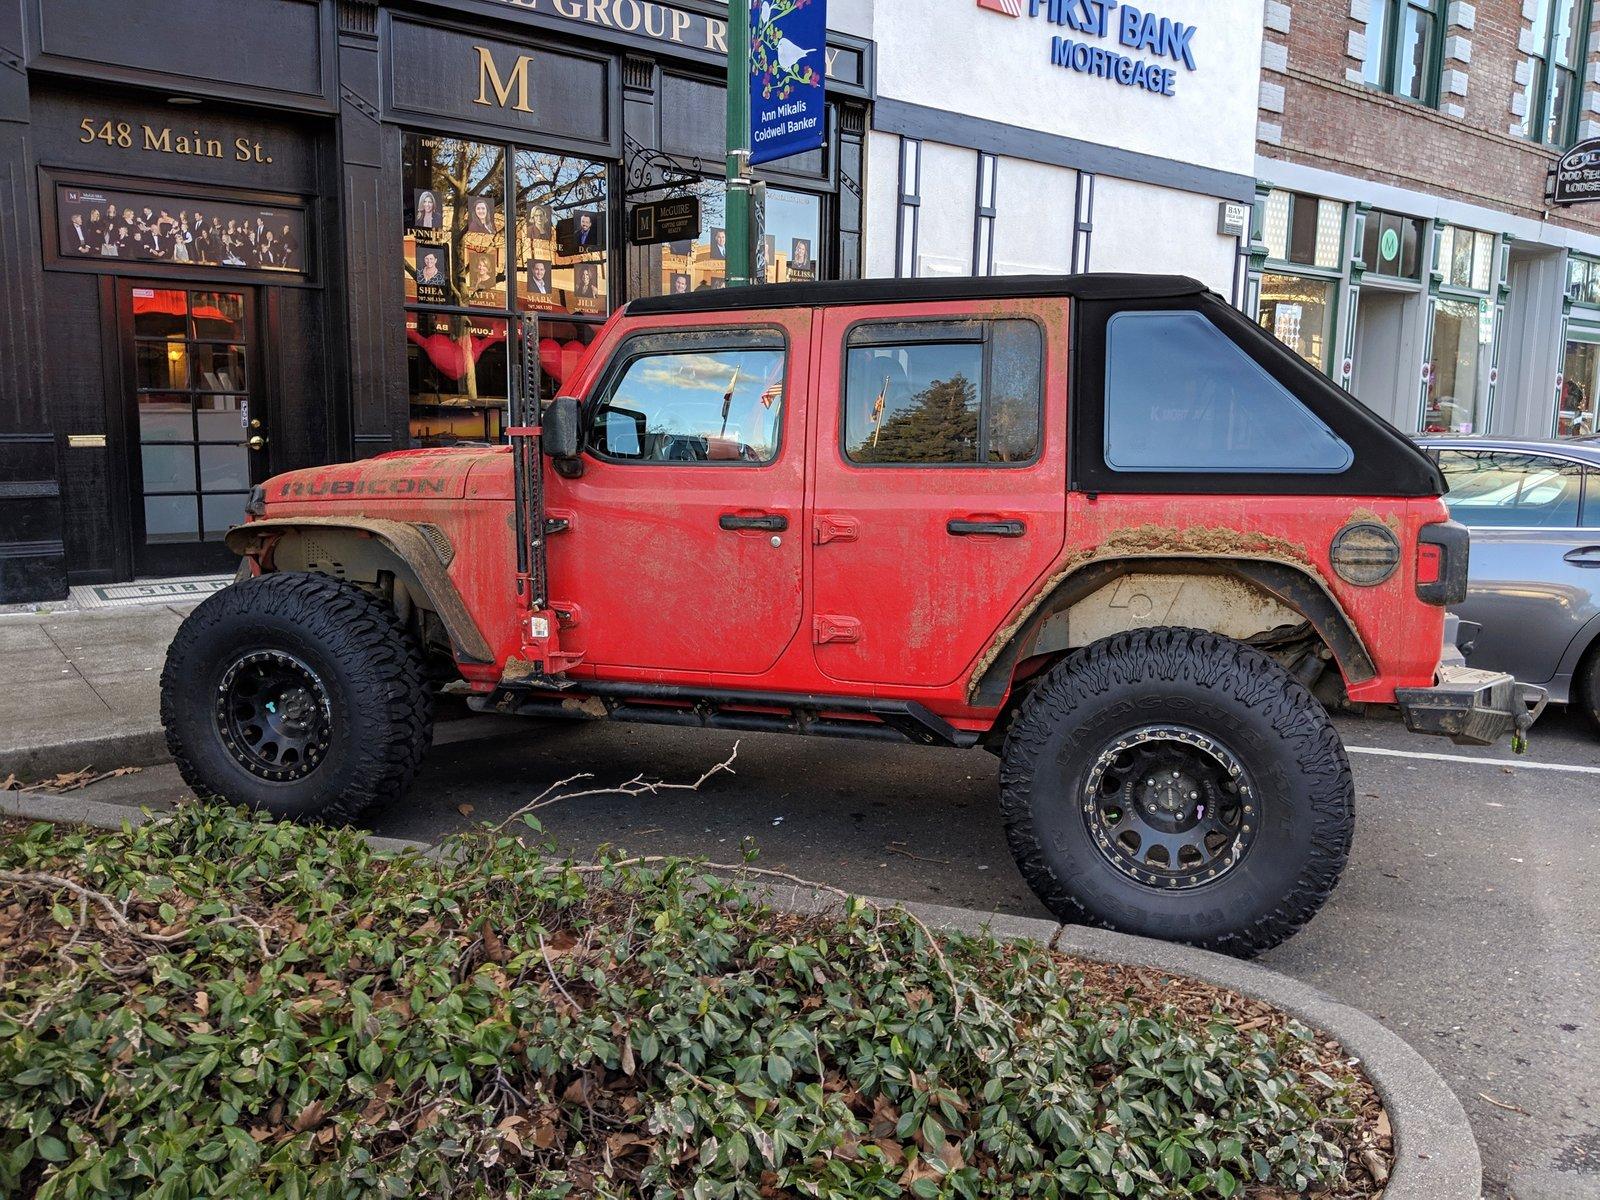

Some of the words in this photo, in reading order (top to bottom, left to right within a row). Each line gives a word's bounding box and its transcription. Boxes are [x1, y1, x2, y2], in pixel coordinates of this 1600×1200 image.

[554, 0, 692, 42] GROUP
[1119, 5, 1197, 71] BANK
[1051, 36, 1177, 97] MORTGAGE
[473, 46, 534, 113] M
[761, 110, 776, 123] Ann
[777, 100, 807, 118] Mikalis
[79, 117, 133, 148] 548
[140, 124, 224, 158] Main
[235, 137, 273, 164] St.
[754, 122, 786, 142] Coldwell
[787, 116, 818, 133] Banker
[1560, 171, 1582, 182] ODD
[640, 215, 649, 231] M
[660, 204, 690, 217] McGUIRE
[1228, 206, 1242, 215] BAY
[419, 286, 444, 296] SHEA
[468, 291, 497, 301] PATTY
[527, 294, 553, 304] MARK
[577, 298, 596, 307] JILL
[280, 478, 447, 497] RUBICON
